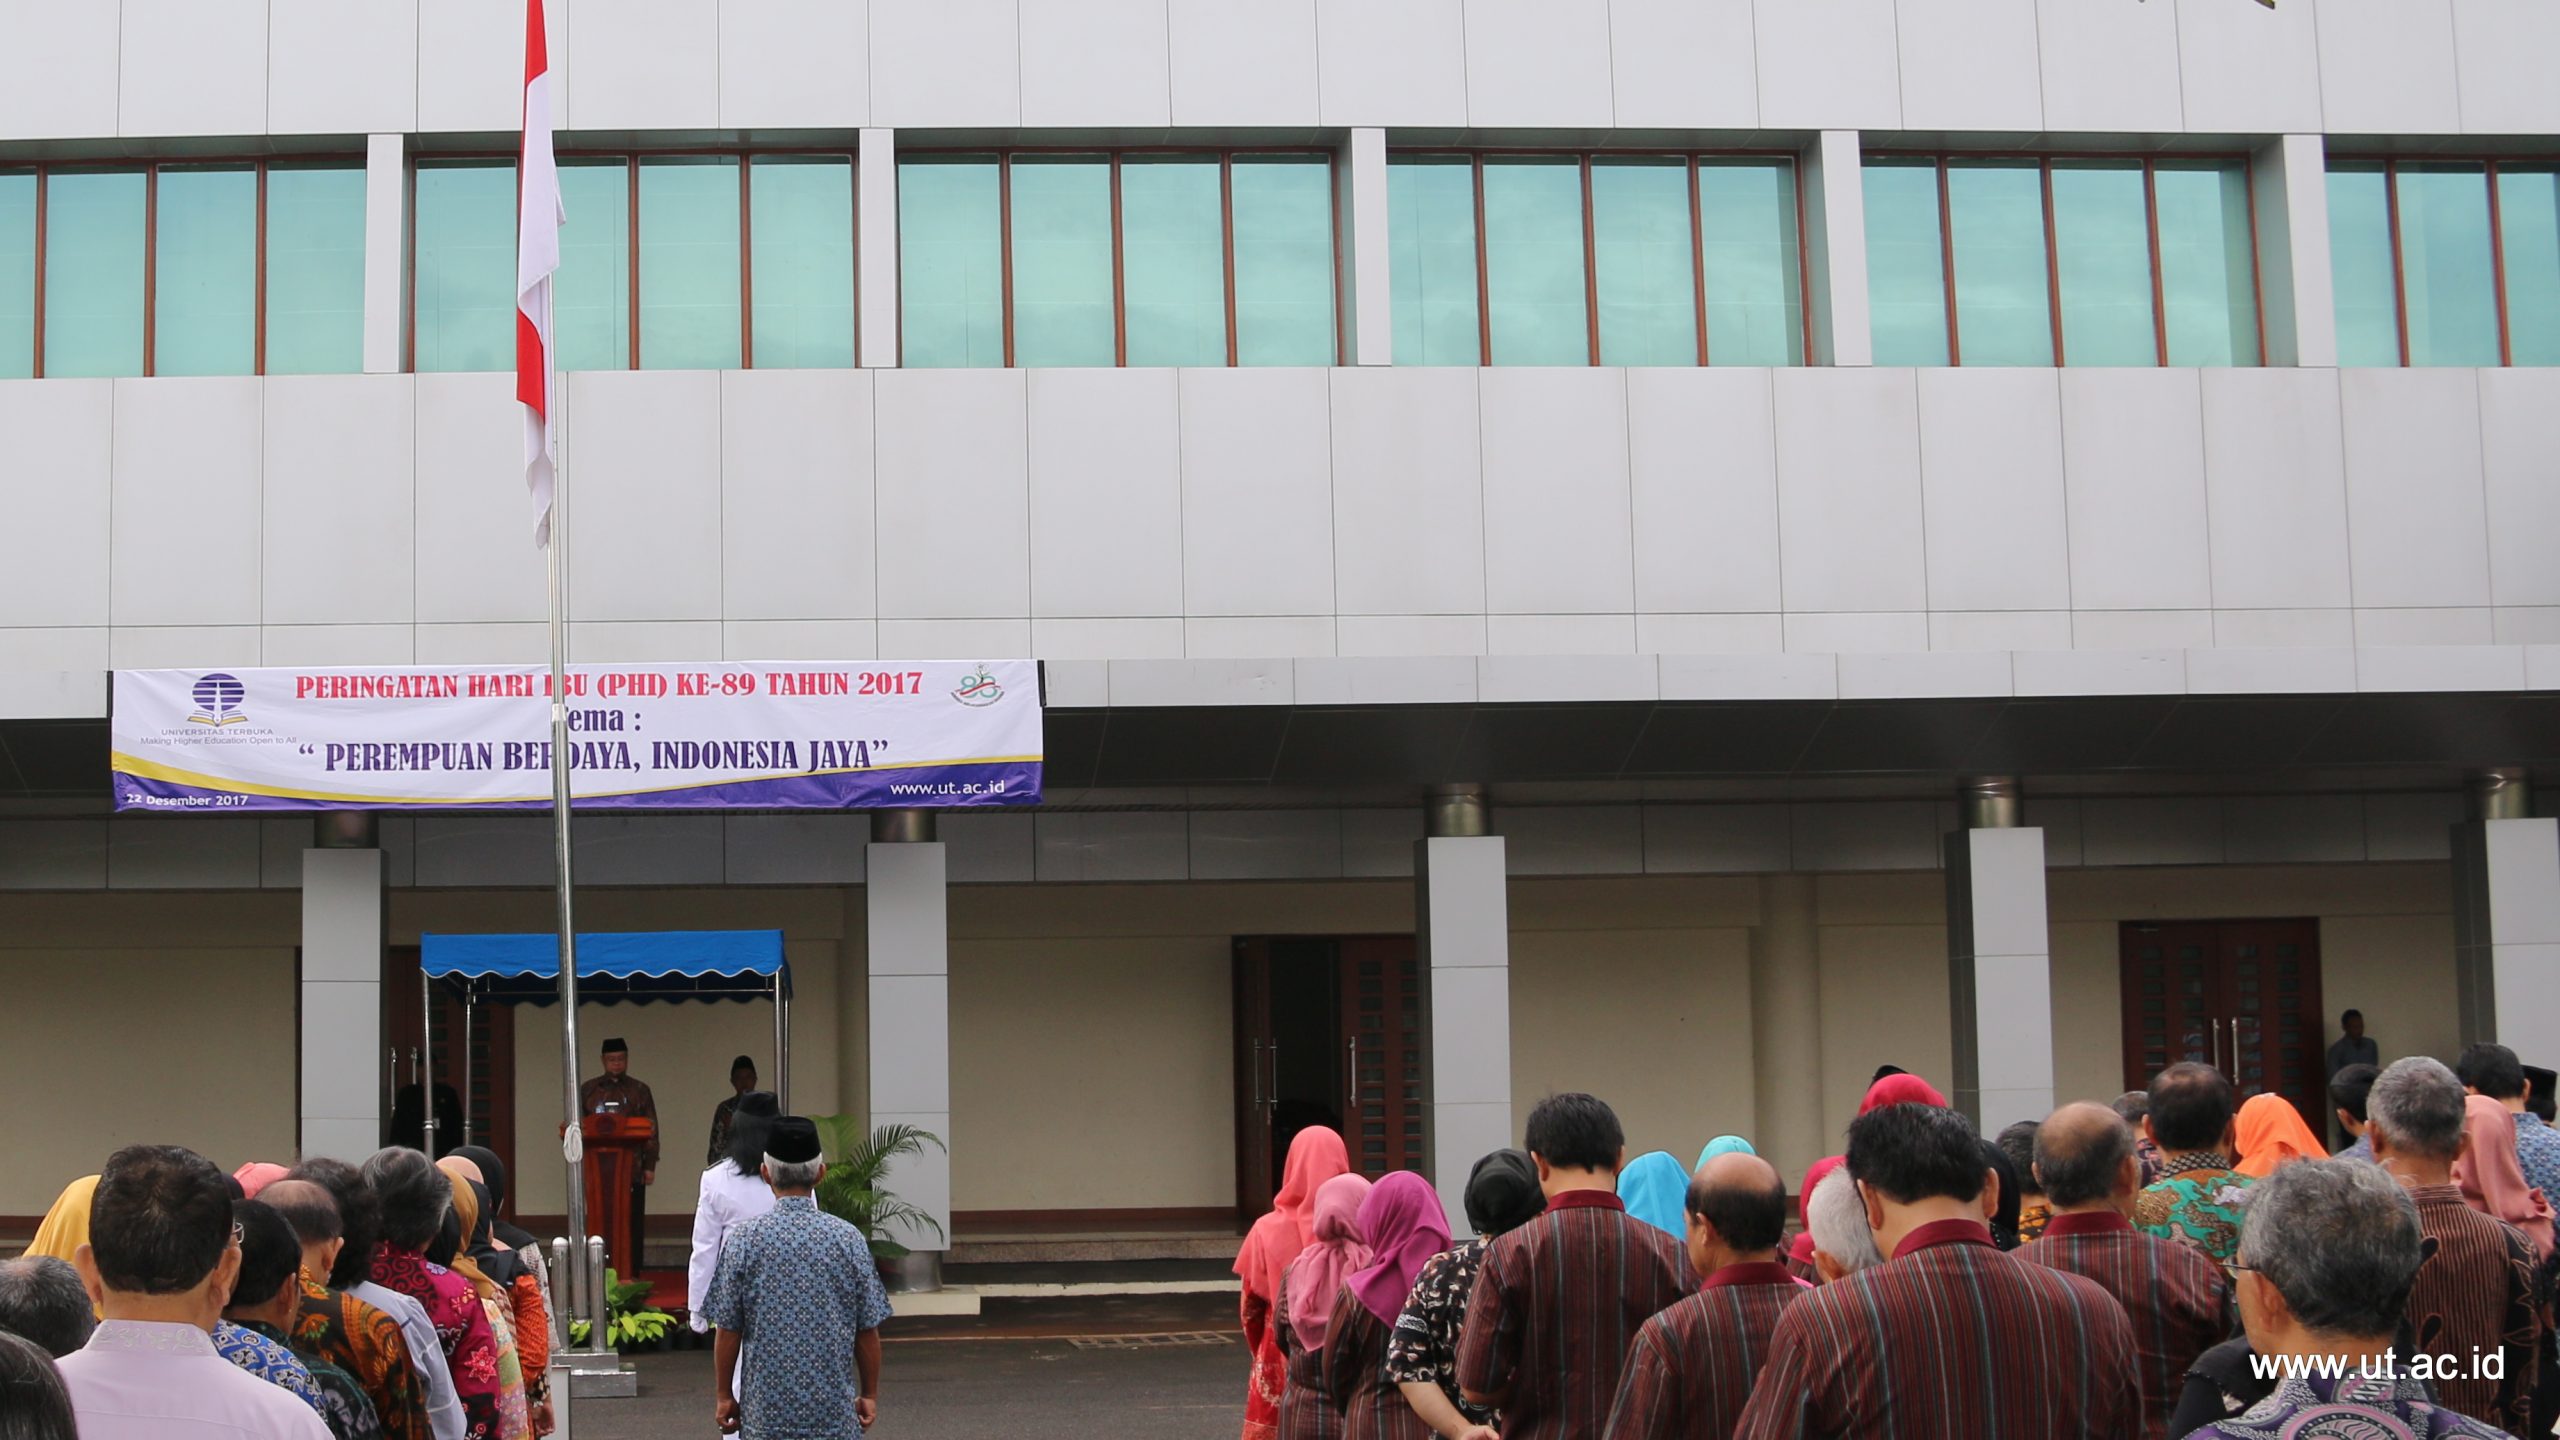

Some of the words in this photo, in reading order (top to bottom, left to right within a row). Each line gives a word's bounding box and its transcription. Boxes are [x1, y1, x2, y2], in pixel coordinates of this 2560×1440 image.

[296, 674, 458, 699] PERINGATAN
[467, 674, 534, 697] HARI
[597, 673, 668, 699] (PHI)
[676, 673, 756, 696] KE-89
[765, 673, 849, 696] TAHUN
[858, 672, 923, 695] 2017
[565, 706, 624, 732] ema
[161, 728, 224, 736] UNIVERSITAS
[228, 728, 274, 736] TERBUKA
[140, 737, 172, 746] Making
[174, 737, 201, 746] Higher
[204, 736, 247, 745] Education
[249, 737, 273, 746] Open
[286, 736, 297, 744] All
[325, 742, 493, 771] PEREMPUAN
[651, 740, 798, 769] INDONESIA
[808, 740, 888, 773] JAYA”
[890, 780, 1006, 796] www.ut.ac.id
[126, 793, 142, 803] 22
[146, 796, 211, 806] Desember
[216, 795, 248, 806] 2017
